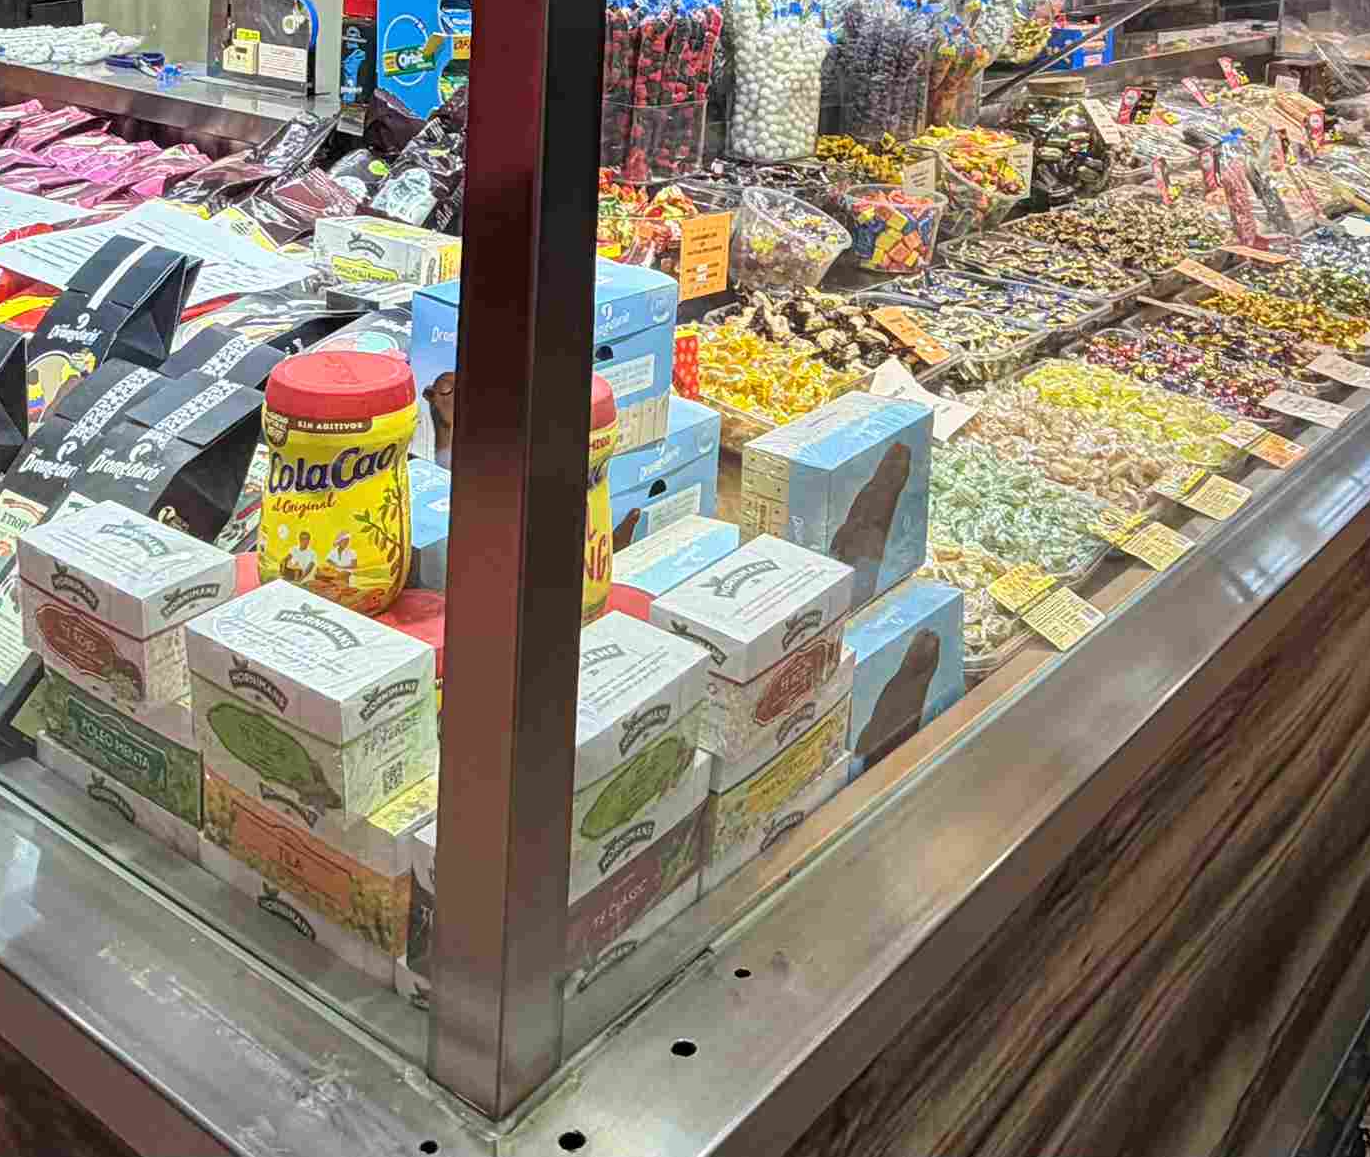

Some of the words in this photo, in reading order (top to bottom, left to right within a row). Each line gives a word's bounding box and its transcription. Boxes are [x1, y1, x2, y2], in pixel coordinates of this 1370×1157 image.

[297, 421, 314, 429] SIN
[87, 453, 165, 481] Dromedario
[282, 491, 336, 516] Original
[279, 609, 356, 649] HORNIMANS
[231, 670, 287, 711] HORNIMANS
